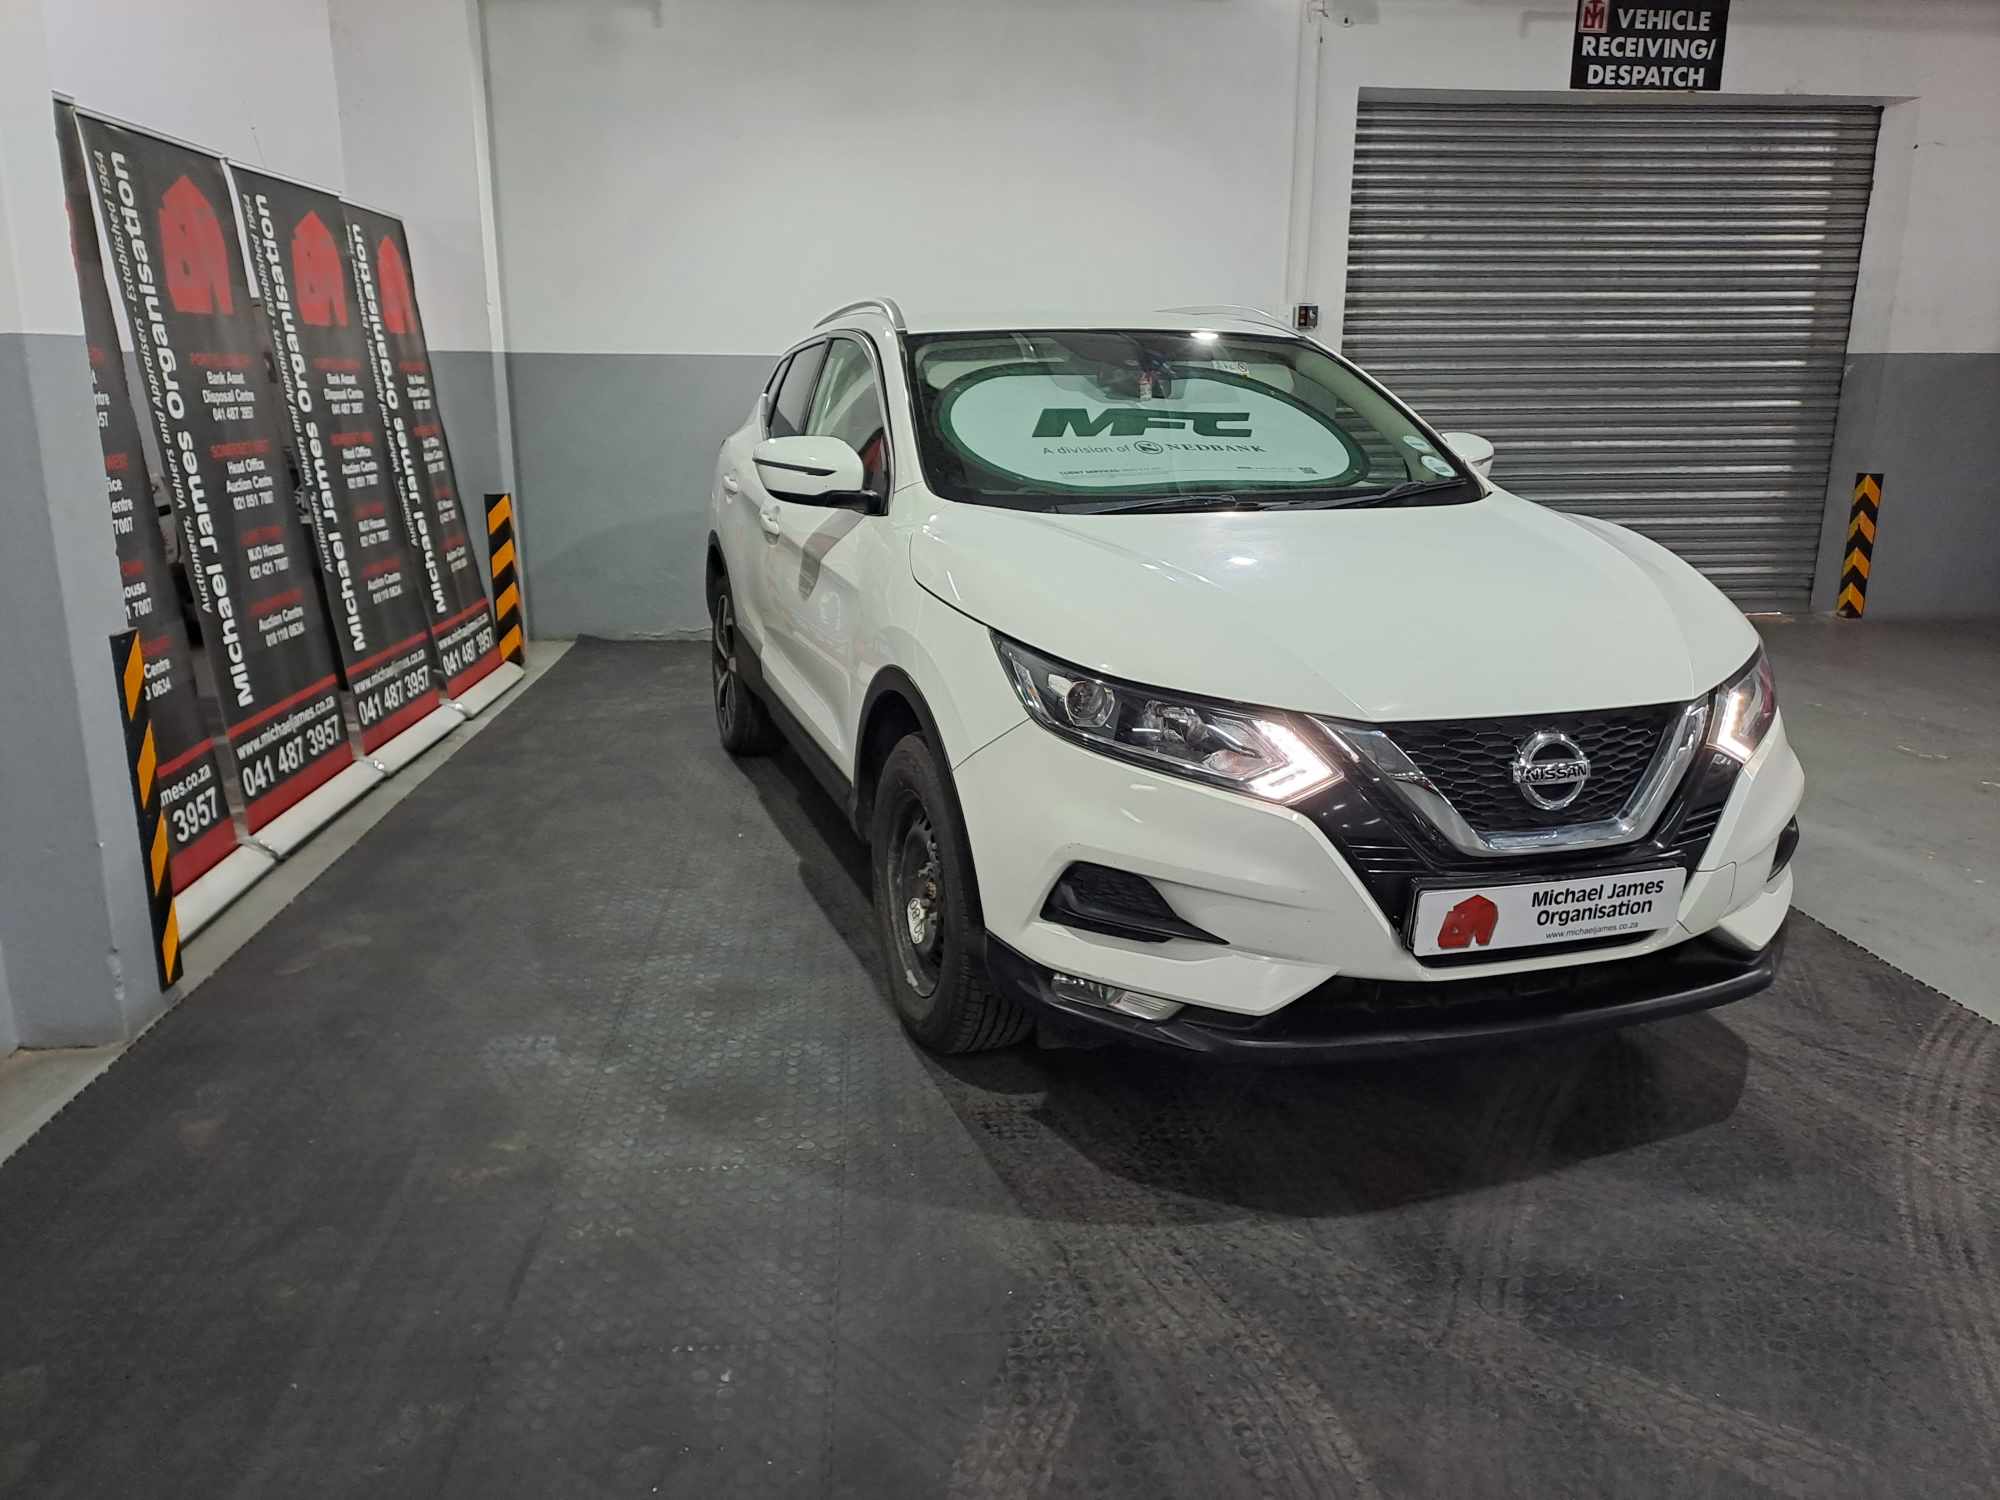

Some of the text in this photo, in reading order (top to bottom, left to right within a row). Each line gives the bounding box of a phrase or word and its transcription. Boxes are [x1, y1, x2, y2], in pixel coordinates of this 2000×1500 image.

[1581, 36, 1716, 60] RECEIVING/
[1617, 8, 1711, 31] VEHICLE
[1587, 64, 1705, 87] DESPATCH
[106, 148, 188, 419] Organisation
[249, 191, 314, 412] Organisation
[347, 221, 400, 410] Organisation
[93, 148, 213, 615] Auctioneers, Valuers and Appraisers Established 1964
[1032, 408, 1253, 438] MFC
[1059, 445, 1113, 455] division
[1166, 443, 1266, 453] NEDBANK
[302, 421, 338, 525] James
[391, 416, 420, 505] James
[111, 499, 133, 514] entre
[173, 430, 218, 556] James
[124, 581, 147, 598] ouse
[326, 529, 366, 653] Michael
[412, 509, 446, 616] Michael
[205, 561, 253, 708] Michael
[441, 647, 462, 679] 041
[357, 663, 431, 727] 041 487 3957
[240, 712, 342, 800] 041 487 3957
[1525, 761, 1587, 782] NISSAN
[172, 786, 218, 842] 3957
[1531, 879, 1664, 908] Michael James
[1536, 899, 1653, 926] Organisation
